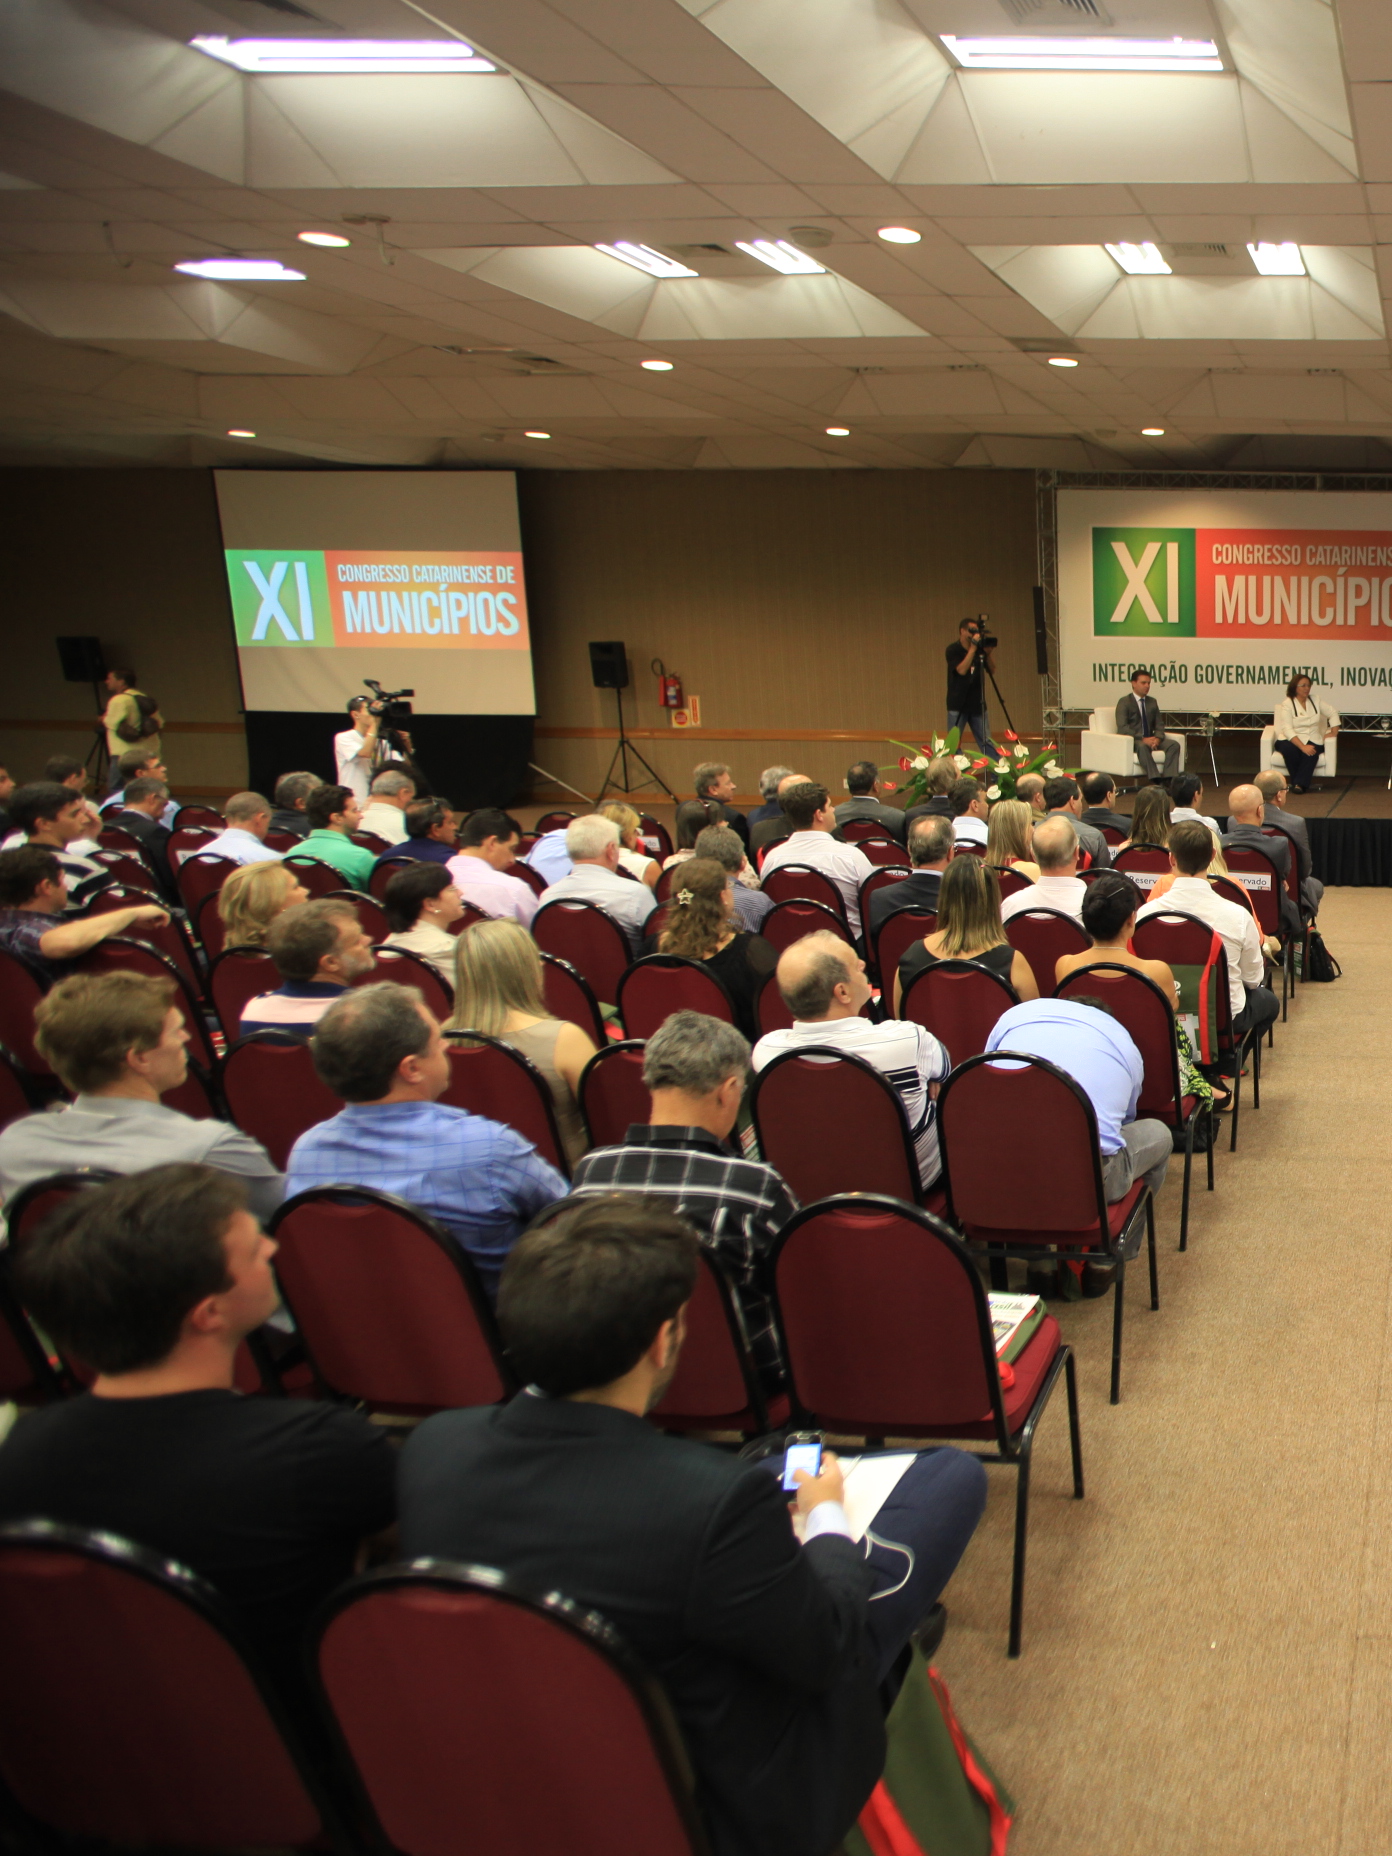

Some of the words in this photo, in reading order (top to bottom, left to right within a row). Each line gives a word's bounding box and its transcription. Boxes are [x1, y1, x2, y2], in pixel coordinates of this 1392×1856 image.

[337, 563, 410, 583] CONGRESSO
[412, 565, 494, 584] CATARINENSE
[496, 565, 516, 584] DE
[1212, 543, 1301, 566] CONGRESSO
[242, 560, 315, 641] XI
[1110, 541, 1179, 624] XI
[342, 583, 520, 636] MUNICÍPIOS
[1130, 875, 1158, 884] Reserv
